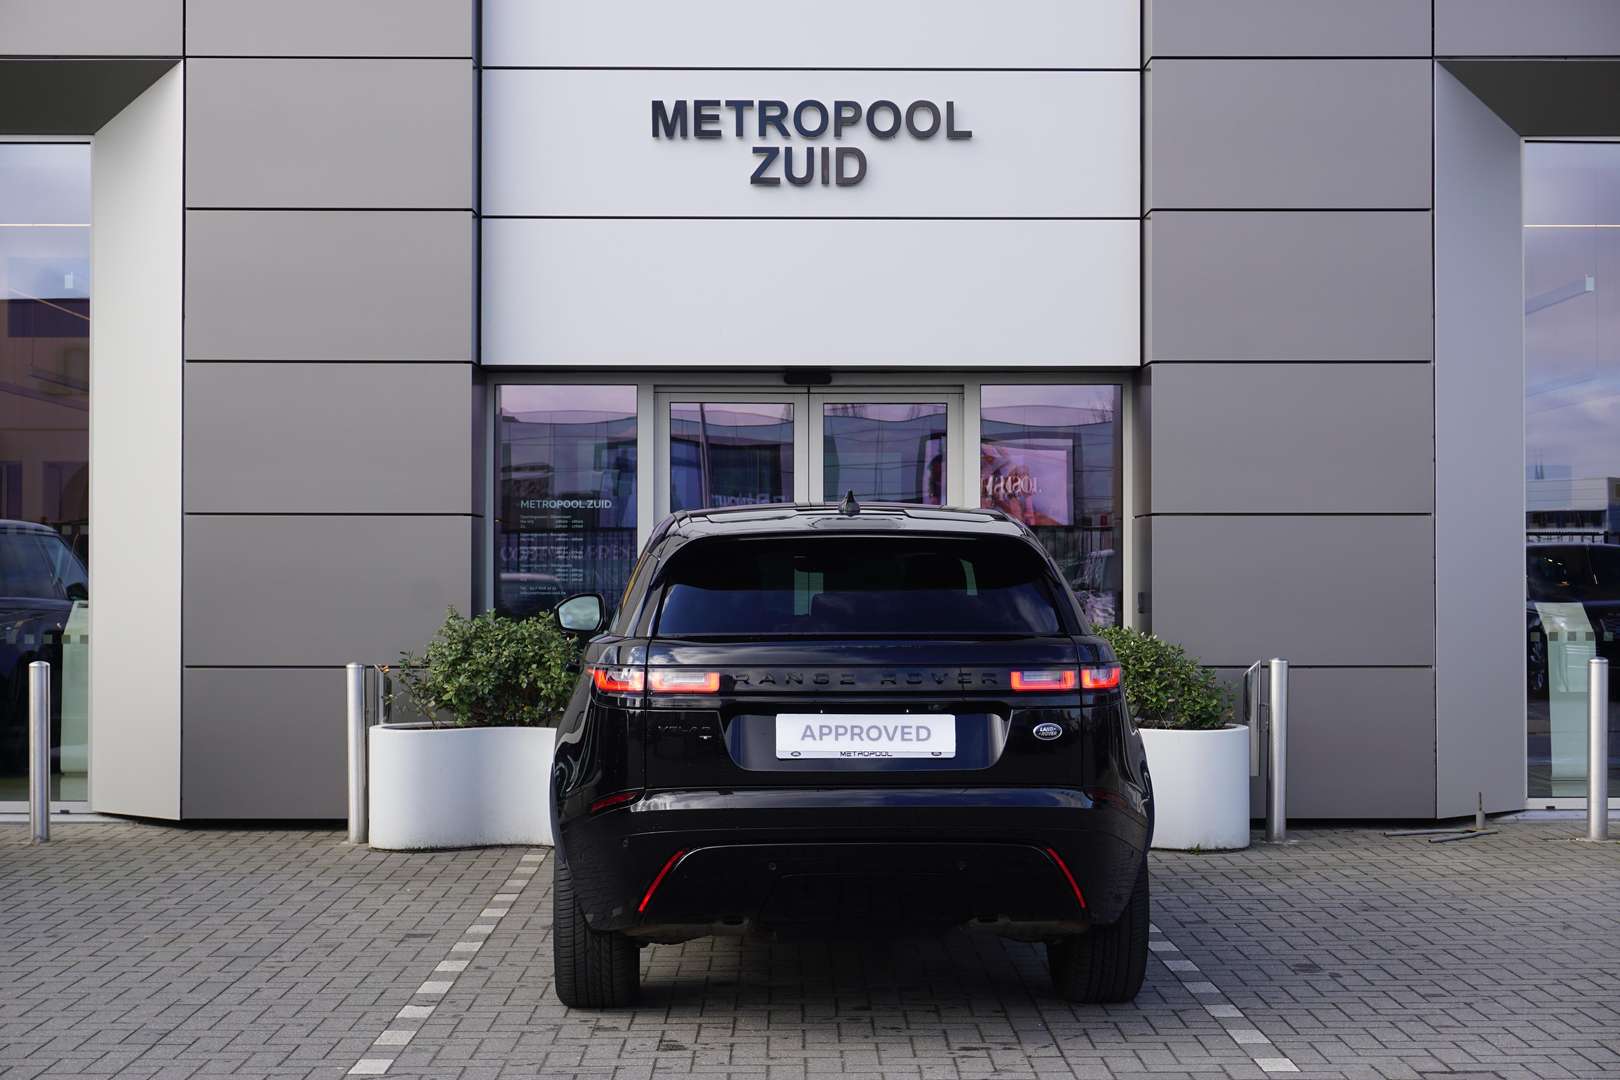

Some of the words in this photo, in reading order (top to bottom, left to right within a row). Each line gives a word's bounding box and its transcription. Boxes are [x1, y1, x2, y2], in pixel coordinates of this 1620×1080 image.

[651, 99, 972, 139] METROPOOL
[750, 146, 868, 187] ZUID
[520, 499, 585, 509] METROPOOL
[586, 499, 612, 509] ZUID
[733, 672, 855, 685] RANGE
[881, 672, 999, 685] ROVER
[800, 724, 932, 742] APPROVED
[839, 750, 893, 758] METROPOOL
